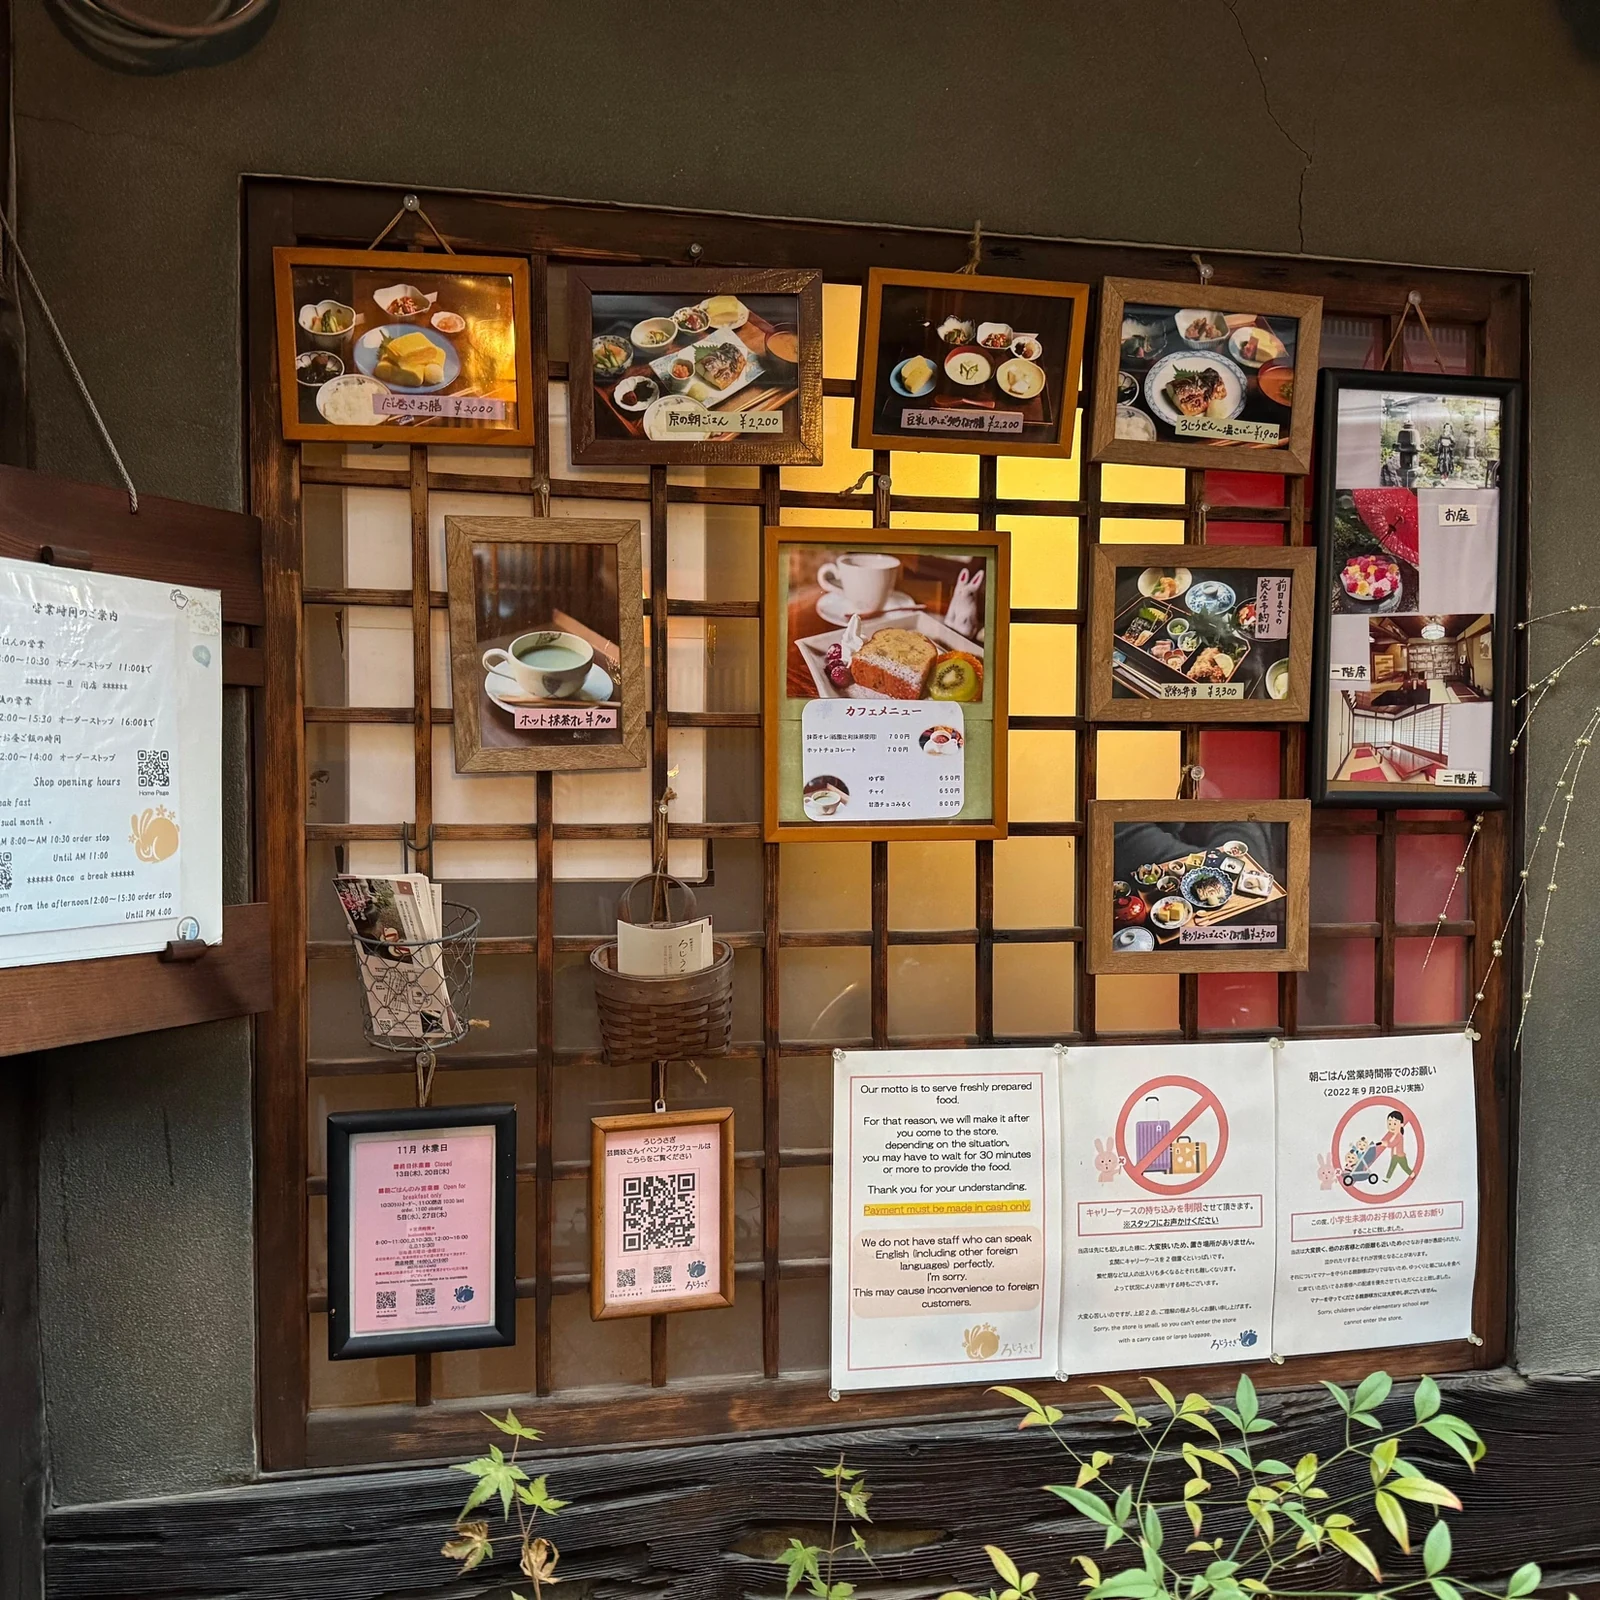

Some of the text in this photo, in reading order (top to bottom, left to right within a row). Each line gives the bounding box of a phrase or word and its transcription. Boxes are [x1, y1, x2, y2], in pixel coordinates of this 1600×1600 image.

[669, 411, 778, 429] 京の朝ごはん ¥2,200
[988, 415, 1019, 432] ¥2,200
[1254, 425, 1279, 440] ¥1,900
[1444, 507, 1470, 522] お庭
[1258, 578, 1271, 634] 完全予約制
[1275, 579, 1287, 625] 前日までの
[32, 602, 117, 622] 営業時間のご案内
[55, 657, 113, 670] オーダーストップ
[1331, 666, 1367, 679] 一階席
[1207, 685, 1237, 697] ¥3,300
[845, 706, 921, 716] カフェメニュー
[58, 715, 114, 725] オーダーストップ
[520, 714, 582, 727] ホット抹茶オレ
[59, 752, 116, 762] オーダーストップ
[32, 776, 120, 788] Shop opening hours
[1443, 771, 1478, 785] 二階席
[50, 833, 110, 844] 10:30 order stop
[52, 851, 108, 862] Until AM 11:00
[55, 873, 74, 882] Once
[87, 871, 108, 880] break
[14, 890, 172, 912] from the order stop
[125, 907, 171, 919] Until PM 4:00
[1250, 928, 1275, 941] ¥2,500
[1309, 1066, 1436, 1082] 朝ごはん営業時間帯でのお願い
[860, 1084, 879, 1093] Our
[880, 1085, 909, 1093] motto
[910, 1084, 918, 1092] is
[959, 1082, 989, 1092] freshly
[991, 1081, 1032, 1091] prepared
[863, 1116, 880, 1125] For
[882, 1116, 901, 1125] that
[955, 1114, 971, 1123] will
[972, 1114, 998, 1123] make
[999, 1114, 1006, 1122] it
[1007, 1113, 1030, 1122] after
[896, 1130, 913, 1138] you
[915, 1129, 941, 1137] come
[943, 1128, 953, 1136] to
[955, 1127, 971, 1136] the
[643, 1136, 676, 1145] ろじうさぎ
[884, 1140, 934, 1150] depending
[951, 1139, 966, 1148] the
[397, 1143, 447, 1154] 11月 休業日
[627, 1153, 692, 1163] こちらをご覧ください
[862, 1155, 879, 1163] you
[881, 1154, 901, 1162] may
[903, 1152, 927, 1161] have
[940, 1151, 961, 1160] wait
[963, 1150, 977, 1160] for
[979, 1150, 993, 1159] 30
[995, 1150, 1031, 1159] minutes
[921, 1165, 932, 1173] to
[933, 1163, 968, 1173] provide
[970, 1162, 986, 1171] the
[867, 1184, 898, 1194] Thank
[899, 1186, 917, 1194] you
[919, 1183, 933, 1193] for
[935, 1185, 956, 1193] your
[864, 1205, 904, 1216] Payment
[907, 1204, 930, 1213] must
[933, 1204, 944, 1212] be
[949, 1203, 972, 1212] made
[975, 1203, 983, 1211] in
[986, 1203, 1007, 1211] cash
[1086, 1202, 1253, 1217] キャリーケースの持ち込みを制限させて頂きます。
[1312, 1209, 1444, 1226] この度、小学生未満のお子様の入店をお断り
[861, 1238, 876, 1247] We
[878, 1237, 891, 1246] do
[893, 1238, 910, 1246] not
[911, 1236, 935, 1245] have
[937, 1235, 959, 1245] staff
[961, 1234, 983, 1244] who
[1004, 1233, 1032, 1243] speak
[875, 1249, 909, 1260] English
[958, 1246, 983, 1256] other
[985, 1245, 1018, 1256] foreign
[927, 1272, 940, 1281] I'm
[852, 1287, 873, 1297] This
[875, 1289, 895, 1297] may
[896, 1287, 925, 1295] cause
[926, 1283, 993, 1294] inconvenience
[1007, 1282, 1039, 1292] foreign
